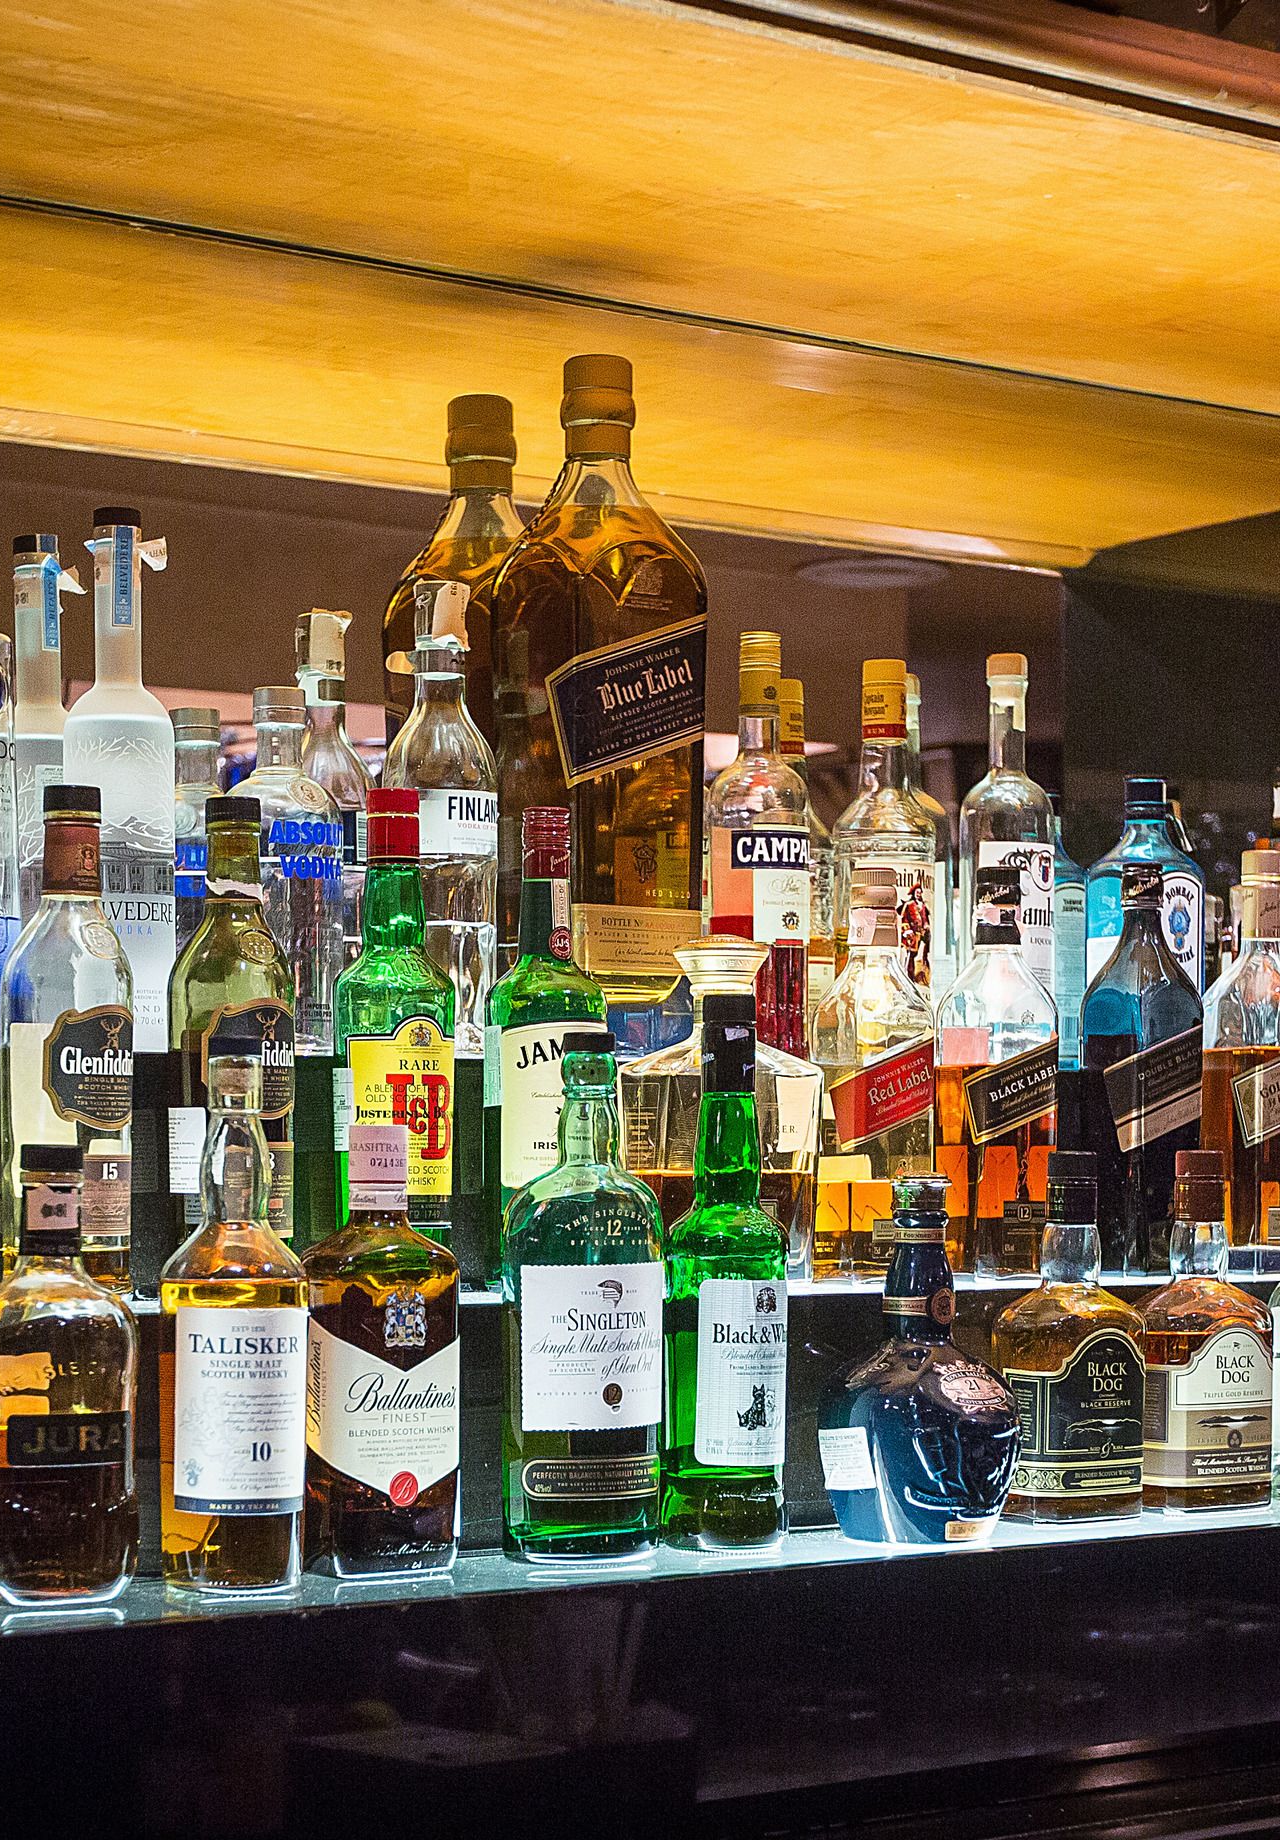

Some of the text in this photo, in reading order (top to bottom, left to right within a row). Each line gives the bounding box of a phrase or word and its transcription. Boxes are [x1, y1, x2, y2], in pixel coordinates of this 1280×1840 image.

[644, 646, 681, 664] WALKER
[596, 658, 693, 714] Blue Label
[1164, 885, 1195, 906] BOMBAY
[601, 916, 632, 928] BOTTLE
[399, 1059, 440, 1071] RARE
[374, 1084, 405, 1093] BLEND
[867, 1065, 931, 1106] Red Label
[988, 1064, 1058, 1103] BLACK LABEL
[365, 1093, 387, 1103] OLD
[101, 1162, 119, 1180] 15
[1020, 1207, 1030, 1218] 12
[606, 1219, 622, 1236] 12
[551, 1307, 646, 1331] THE SINGLETON
[188, 1333, 299, 1355] TALISKER
[529, 1332, 577, 1359] Single
[577, 1333, 609, 1354] Malt
[209, 1359, 283, 1369] SINGLE MALT
[1087, 1361, 1128, 1378] BLACK
[1215, 1354, 1255, 1369] BLACK
[200, 1369, 288, 1379] SCOTCH WHISKY
[1221, 1370, 1250, 1384] DOG
[344, 1371, 457, 1413] Ballantine's
[964, 1379, 981, 1391] 21
[1093, 1377, 1123, 1392] DOG
[1203, 1391, 1224, 1399] TRIPLE
[1225, 1390, 1242, 1398] GOLD
[382, 1412, 427, 1423] FINEST
[23, 1423, 129, 1453] JURA
[348, 1425, 456, 1438] BLENDED SCOTCH WHISKY
[251, 1440, 272, 1462] 10
